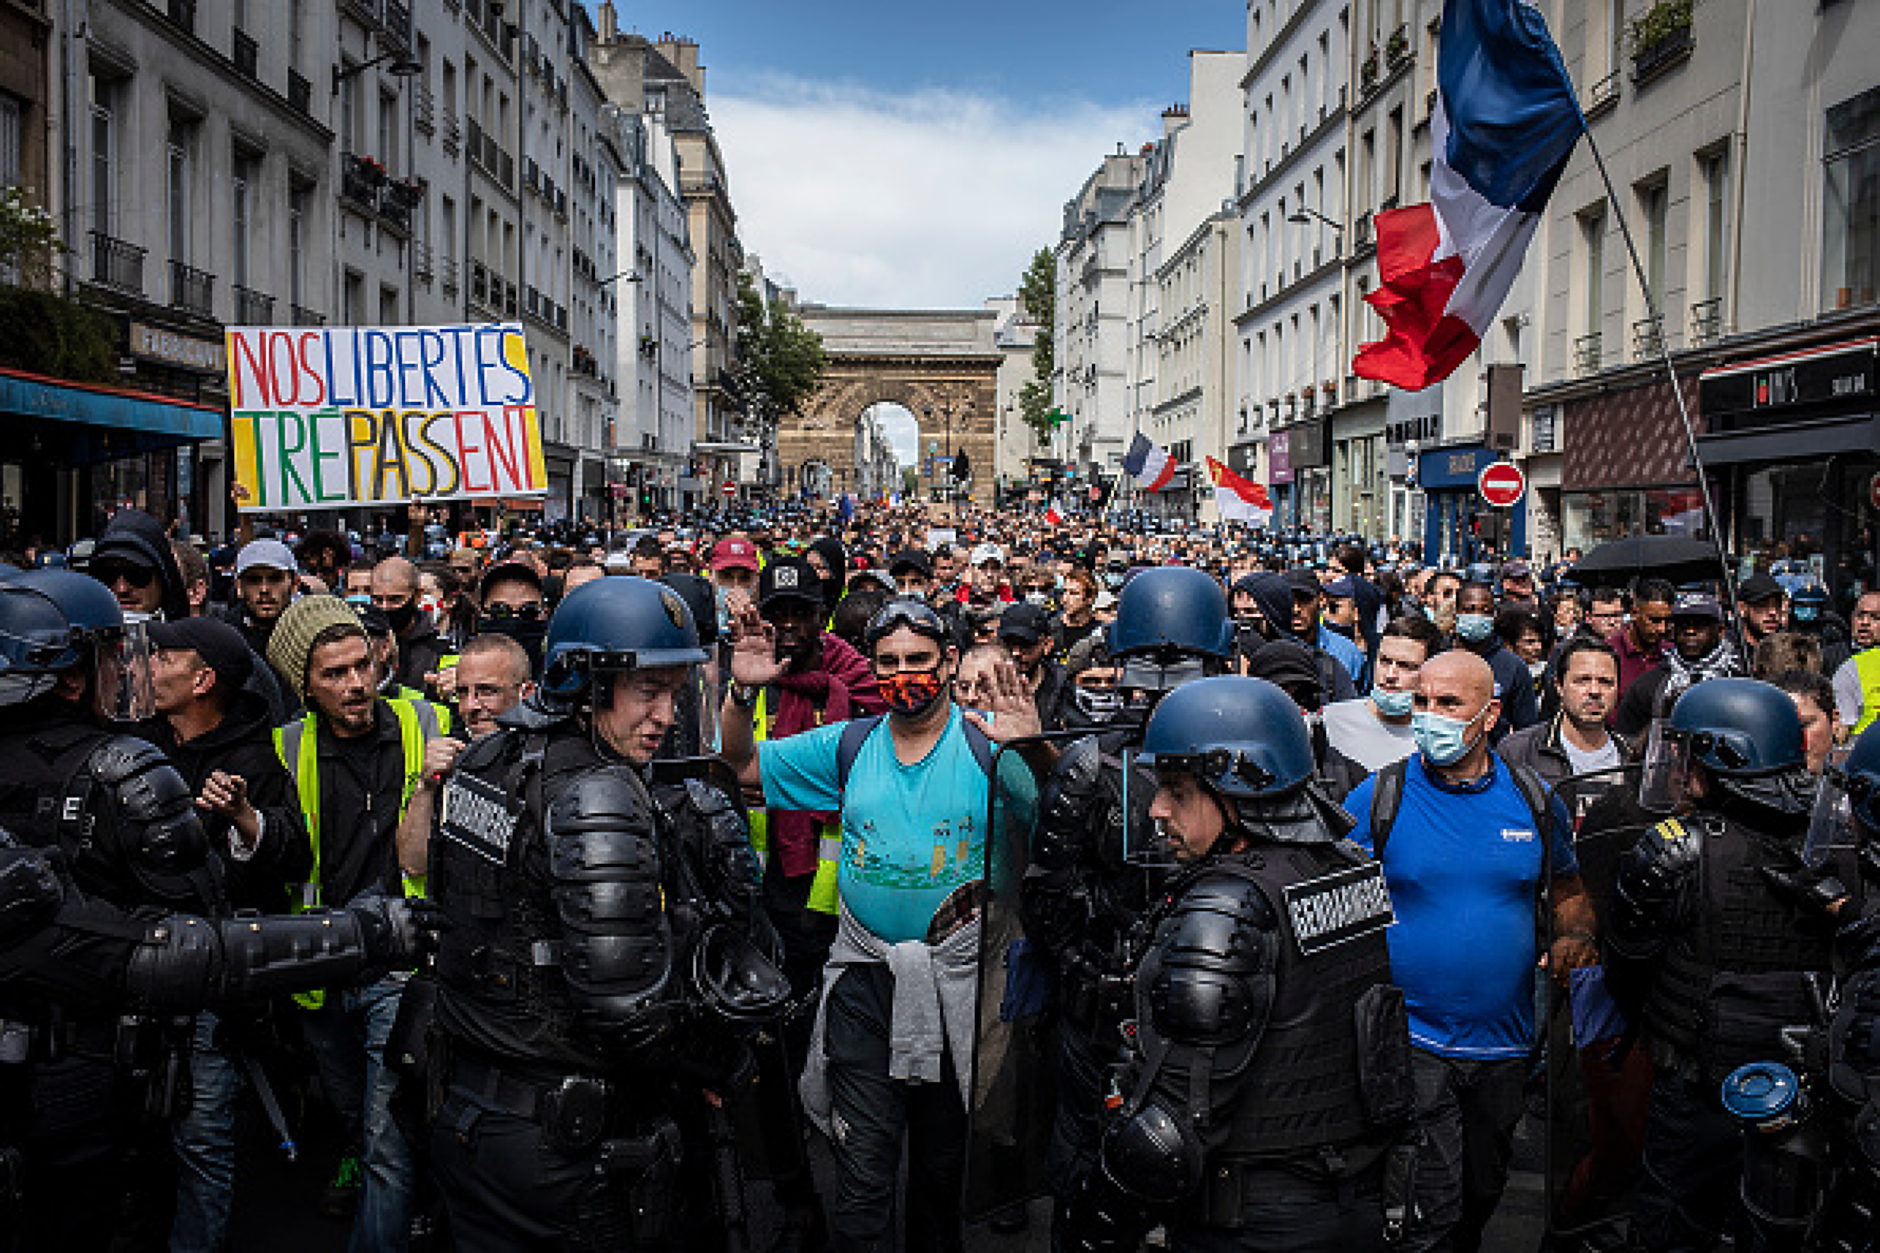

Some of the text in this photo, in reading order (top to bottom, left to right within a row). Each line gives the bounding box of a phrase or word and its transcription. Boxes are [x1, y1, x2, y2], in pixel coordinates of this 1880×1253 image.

[233, 322, 532, 408] NOS LIBERTÉS
[233, 404, 536, 507] TRÉPASSENT
